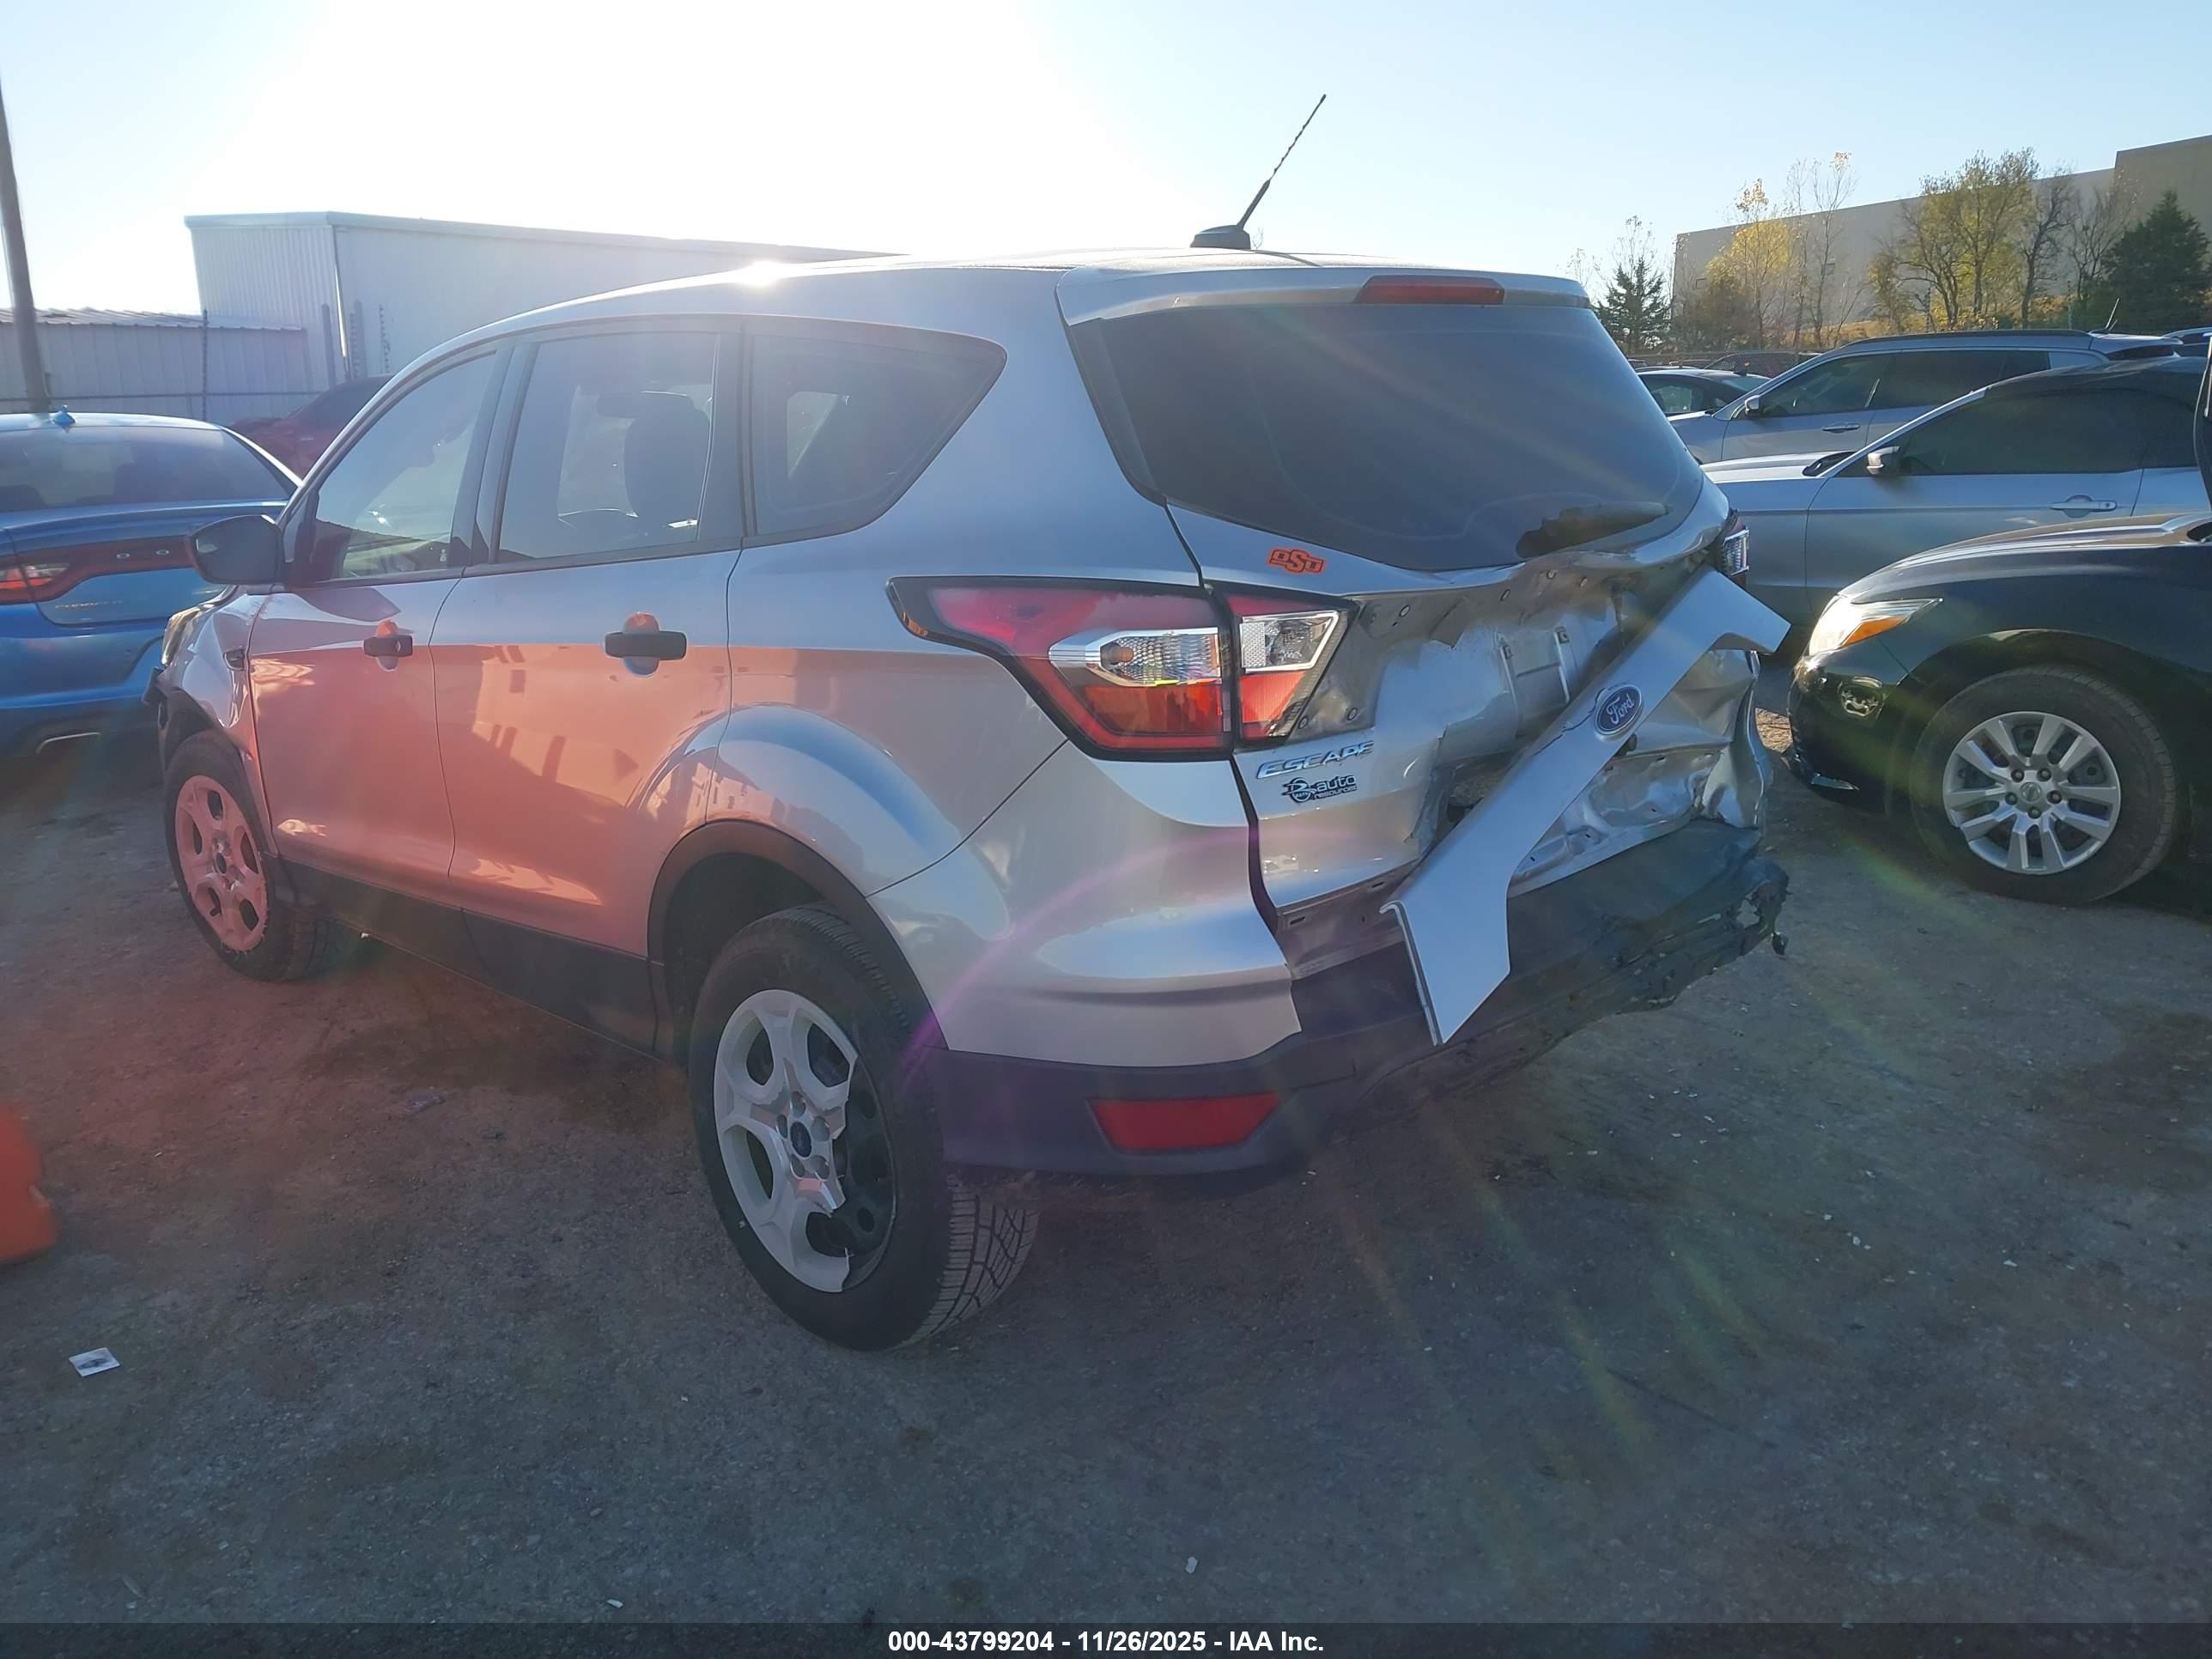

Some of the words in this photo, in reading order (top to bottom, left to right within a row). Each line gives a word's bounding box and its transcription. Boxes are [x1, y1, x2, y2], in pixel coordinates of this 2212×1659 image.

[1606, 693, 1634, 724] Ford
[1257, 740, 1374, 779] ESCAPE
[1316, 775, 1357, 792] auto
